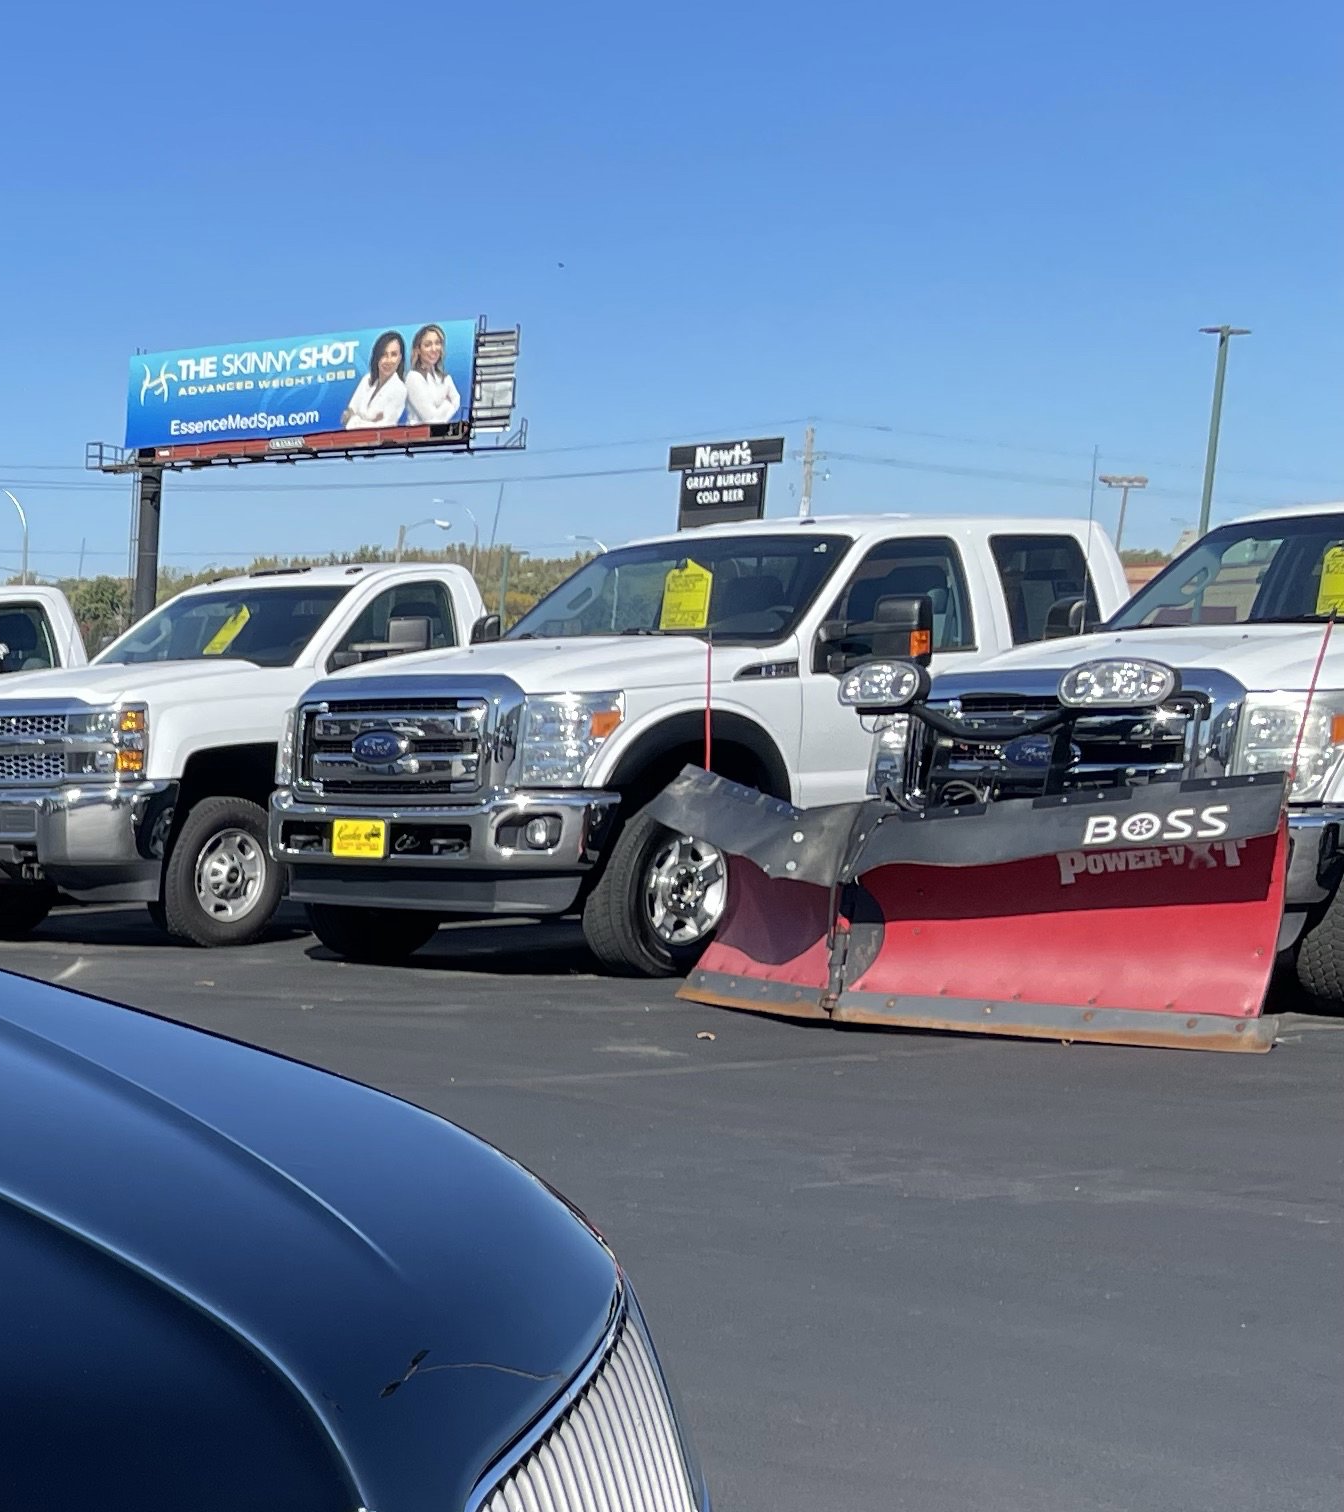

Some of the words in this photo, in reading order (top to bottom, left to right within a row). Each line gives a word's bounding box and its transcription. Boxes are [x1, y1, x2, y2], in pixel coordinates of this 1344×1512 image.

[177, 356, 218, 381] THE
[222, 349, 297, 377] SKINNY
[298, 340, 360, 370] SHOT
[177, 379, 255, 397] ADVANCED
[258, 375, 313, 389] WEIGHT
[317, 369, 356, 384] LOSS
[170, 410, 320, 436] EssenceMedSpa.com
[694, 440, 753, 468] Newt's
[685, 474, 714, 490] GREAT
[716, 472, 759, 487] BURGERS
[695, 491, 720, 504] COLD
[722, 488, 745, 502] BEER
[1082, 804, 1230, 845] BOSS
